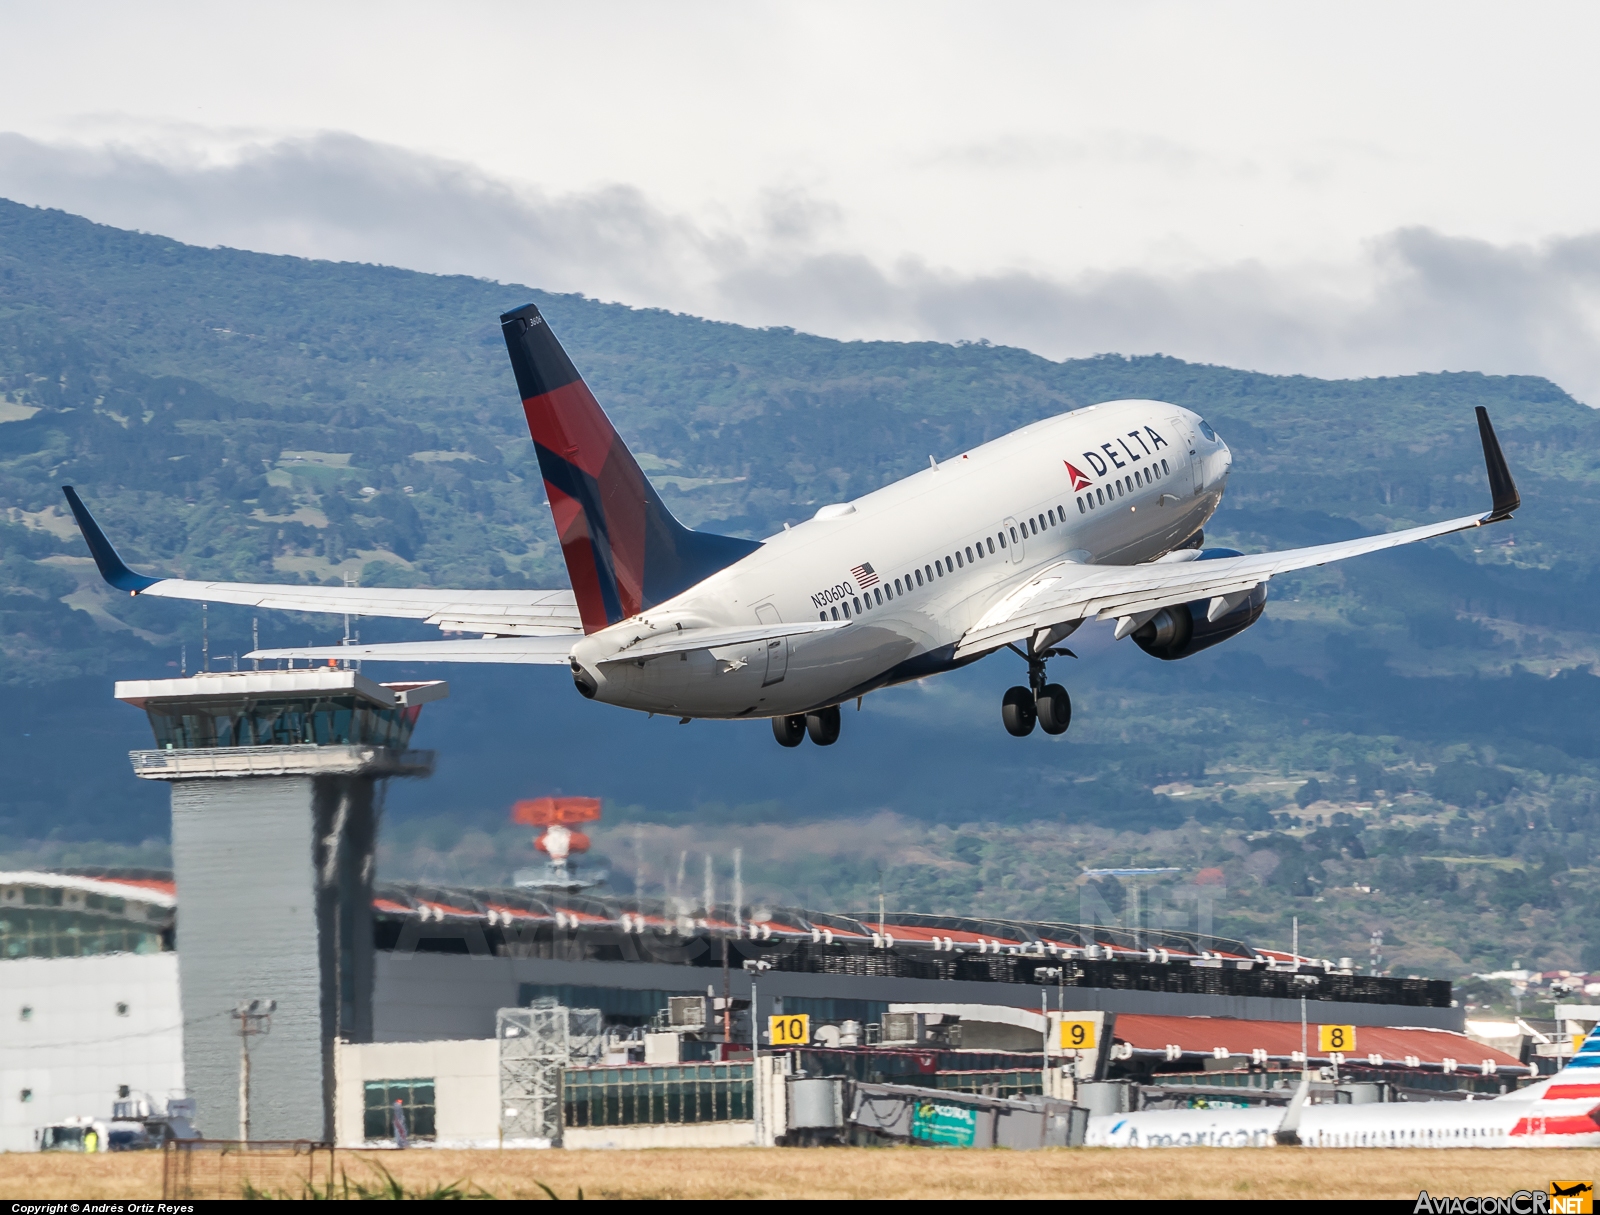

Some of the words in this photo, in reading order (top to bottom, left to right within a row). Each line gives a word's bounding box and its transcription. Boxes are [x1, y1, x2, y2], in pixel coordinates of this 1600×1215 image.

[1083, 425, 1169, 477] DELTA
[810, 581, 855, 609] N306DQ
[775, 1018, 803, 1041] 10
[1071, 1024, 1085, 1045] 9
[1331, 1028, 1344, 1048] 8
[1129, 1123, 1269, 1147] American
